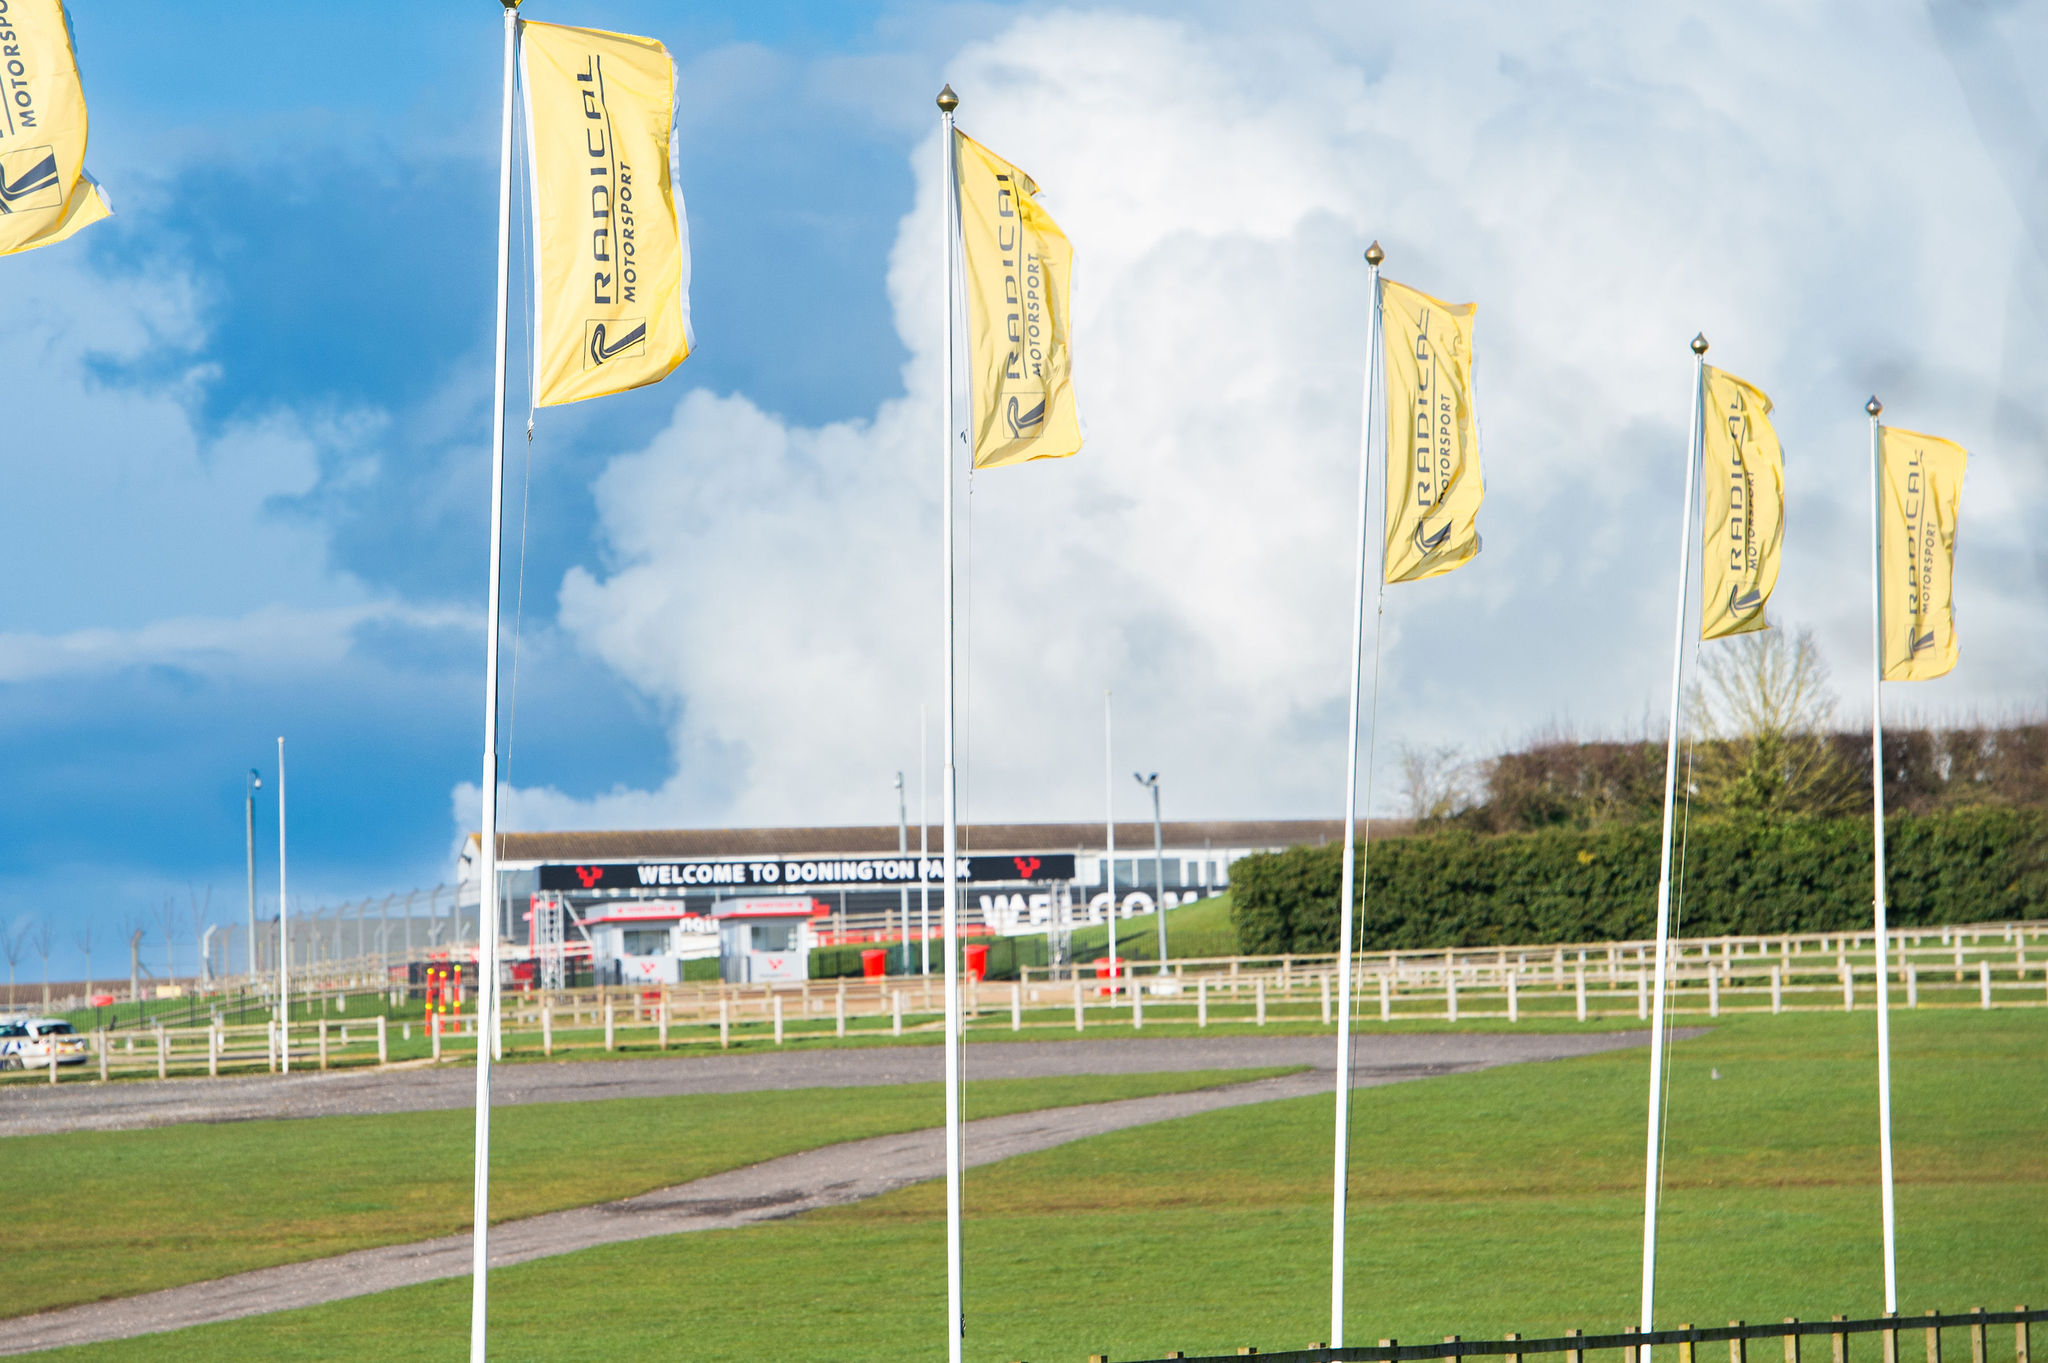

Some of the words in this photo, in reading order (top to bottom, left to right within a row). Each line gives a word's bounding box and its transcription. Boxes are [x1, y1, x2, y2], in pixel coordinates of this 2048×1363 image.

[0, 0, 37, 127] MOTORSPO
[577, 54, 612, 304] RADICAL
[619, 160, 637, 303] MOTORSPORT
[1027, 253, 1042, 377] MOTORSPORT
[1439, 394, 1451, 503] OTORSPORT
[1728, 390, 1743, 570] RADICAL
[1906, 449, 1919, 614] RADICAL
[1922, 521, 1936, 614] MOTORSPORT
[637, 863, 746, 885] WELCOME
[749, 863, 780, 883] TO
[784, 860, 915, 882] DONINGTON
[917, 858, 972, 879] PAK
[979, 891, 1224, 930] WELCO
